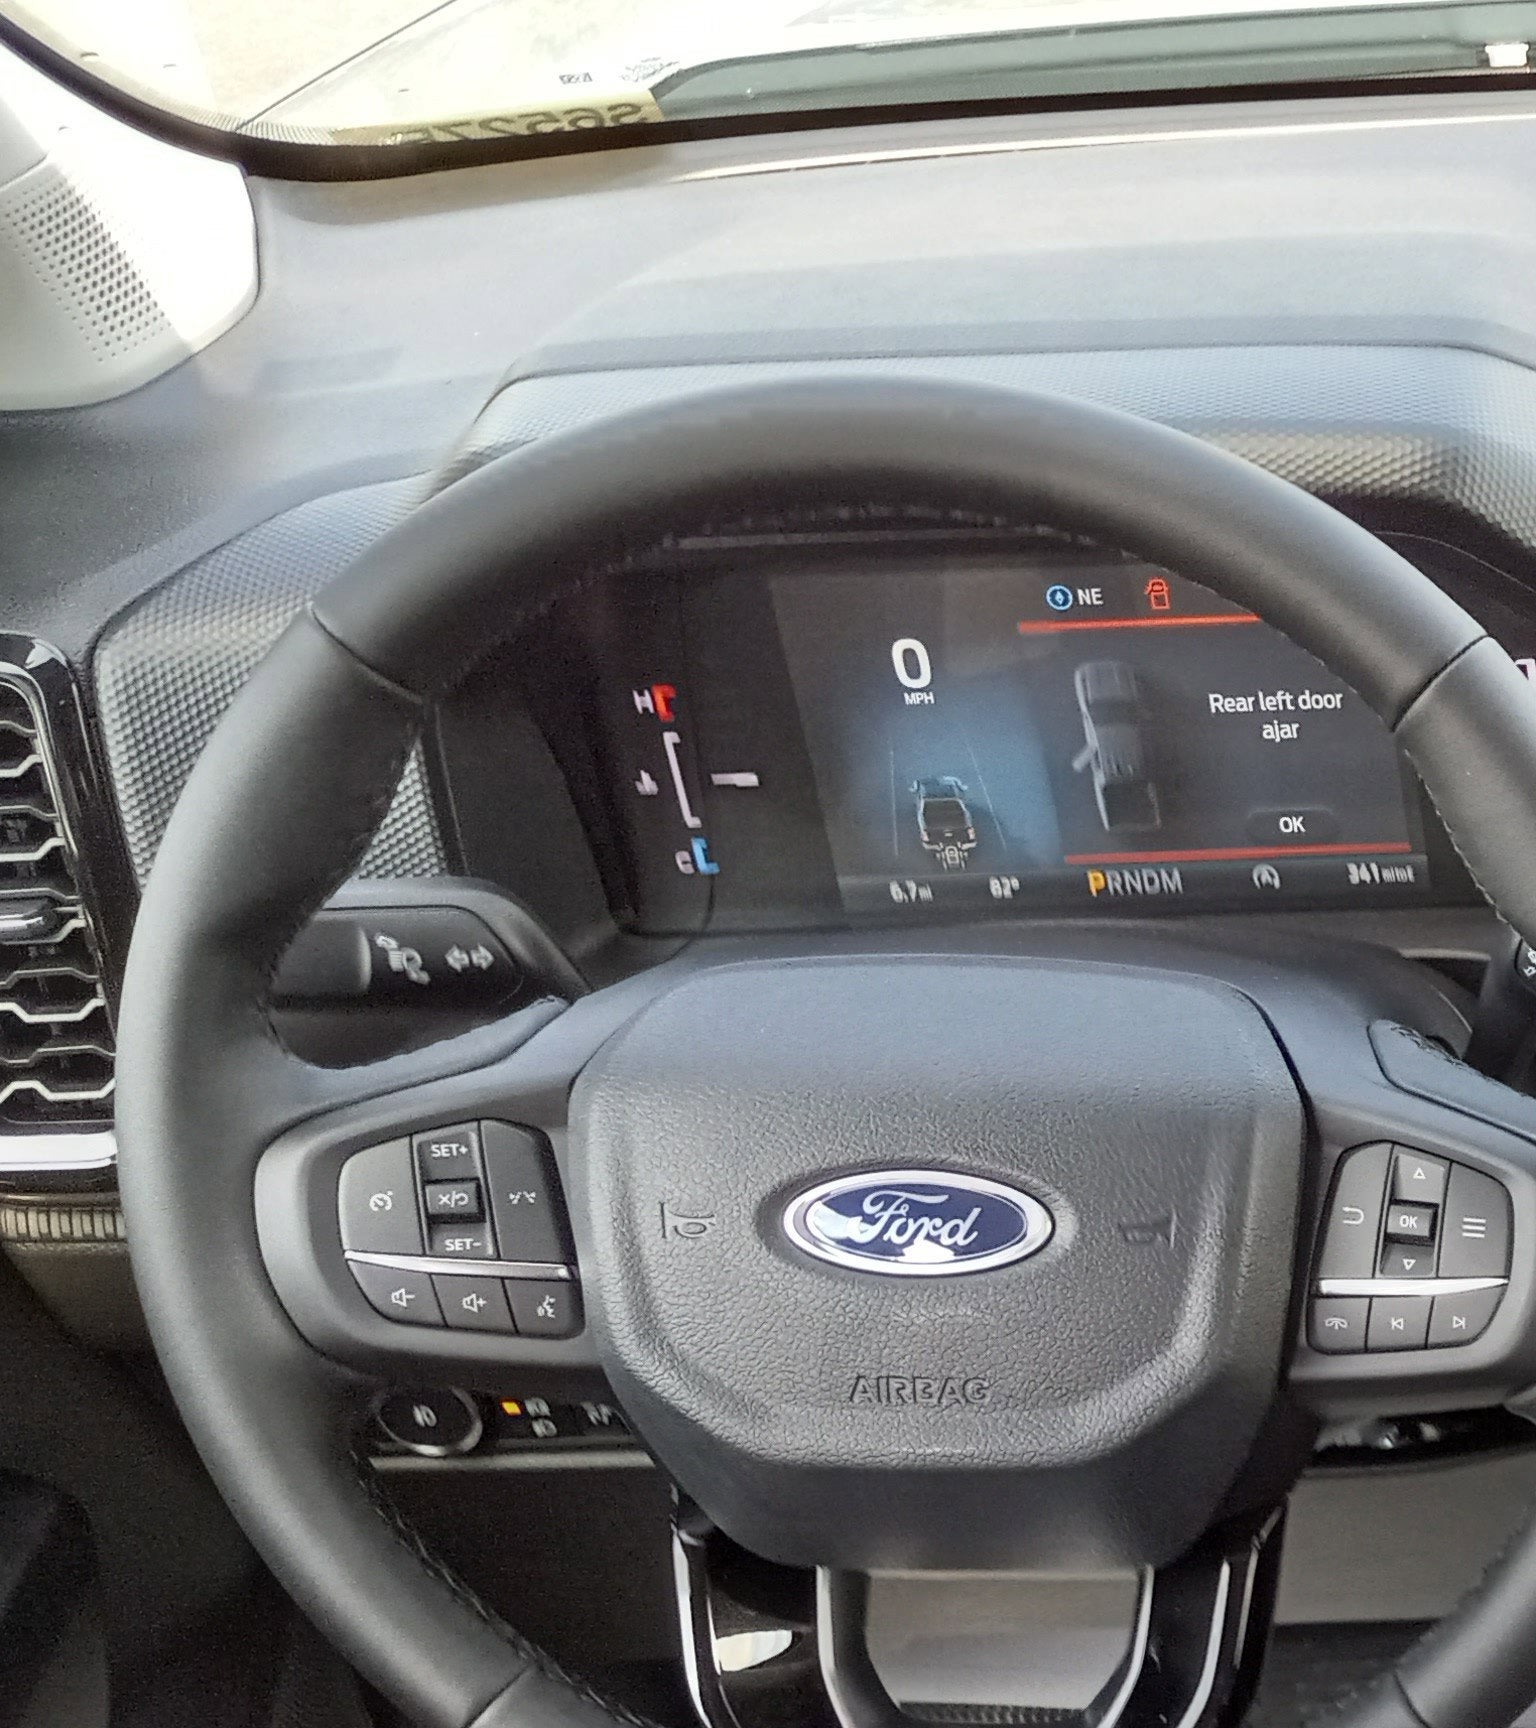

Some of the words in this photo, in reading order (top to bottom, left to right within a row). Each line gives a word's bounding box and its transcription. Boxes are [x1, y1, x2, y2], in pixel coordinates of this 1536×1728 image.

[1077, 588, 1104, 606] NE
[891, 638, 932, 689] 0
[904, 692, 934, 705] MPH
[1208, 692, 1255, 714] Rear
[1258, 690, 1295, 712] left
[1298, 690, 1343, 711] door
[1261, 720, 1301, 742] ajar
[1279, 816, 1306, 833] OK
[1087, 867, 1183, 897] PRNDM
[430, 1143, 469, 1158] SET+
[844, 1188, 981, 1249] Ford
[1398, 1214, 1419, 1230] OK
[849, 1374, 990, 1404] AIRBAG
